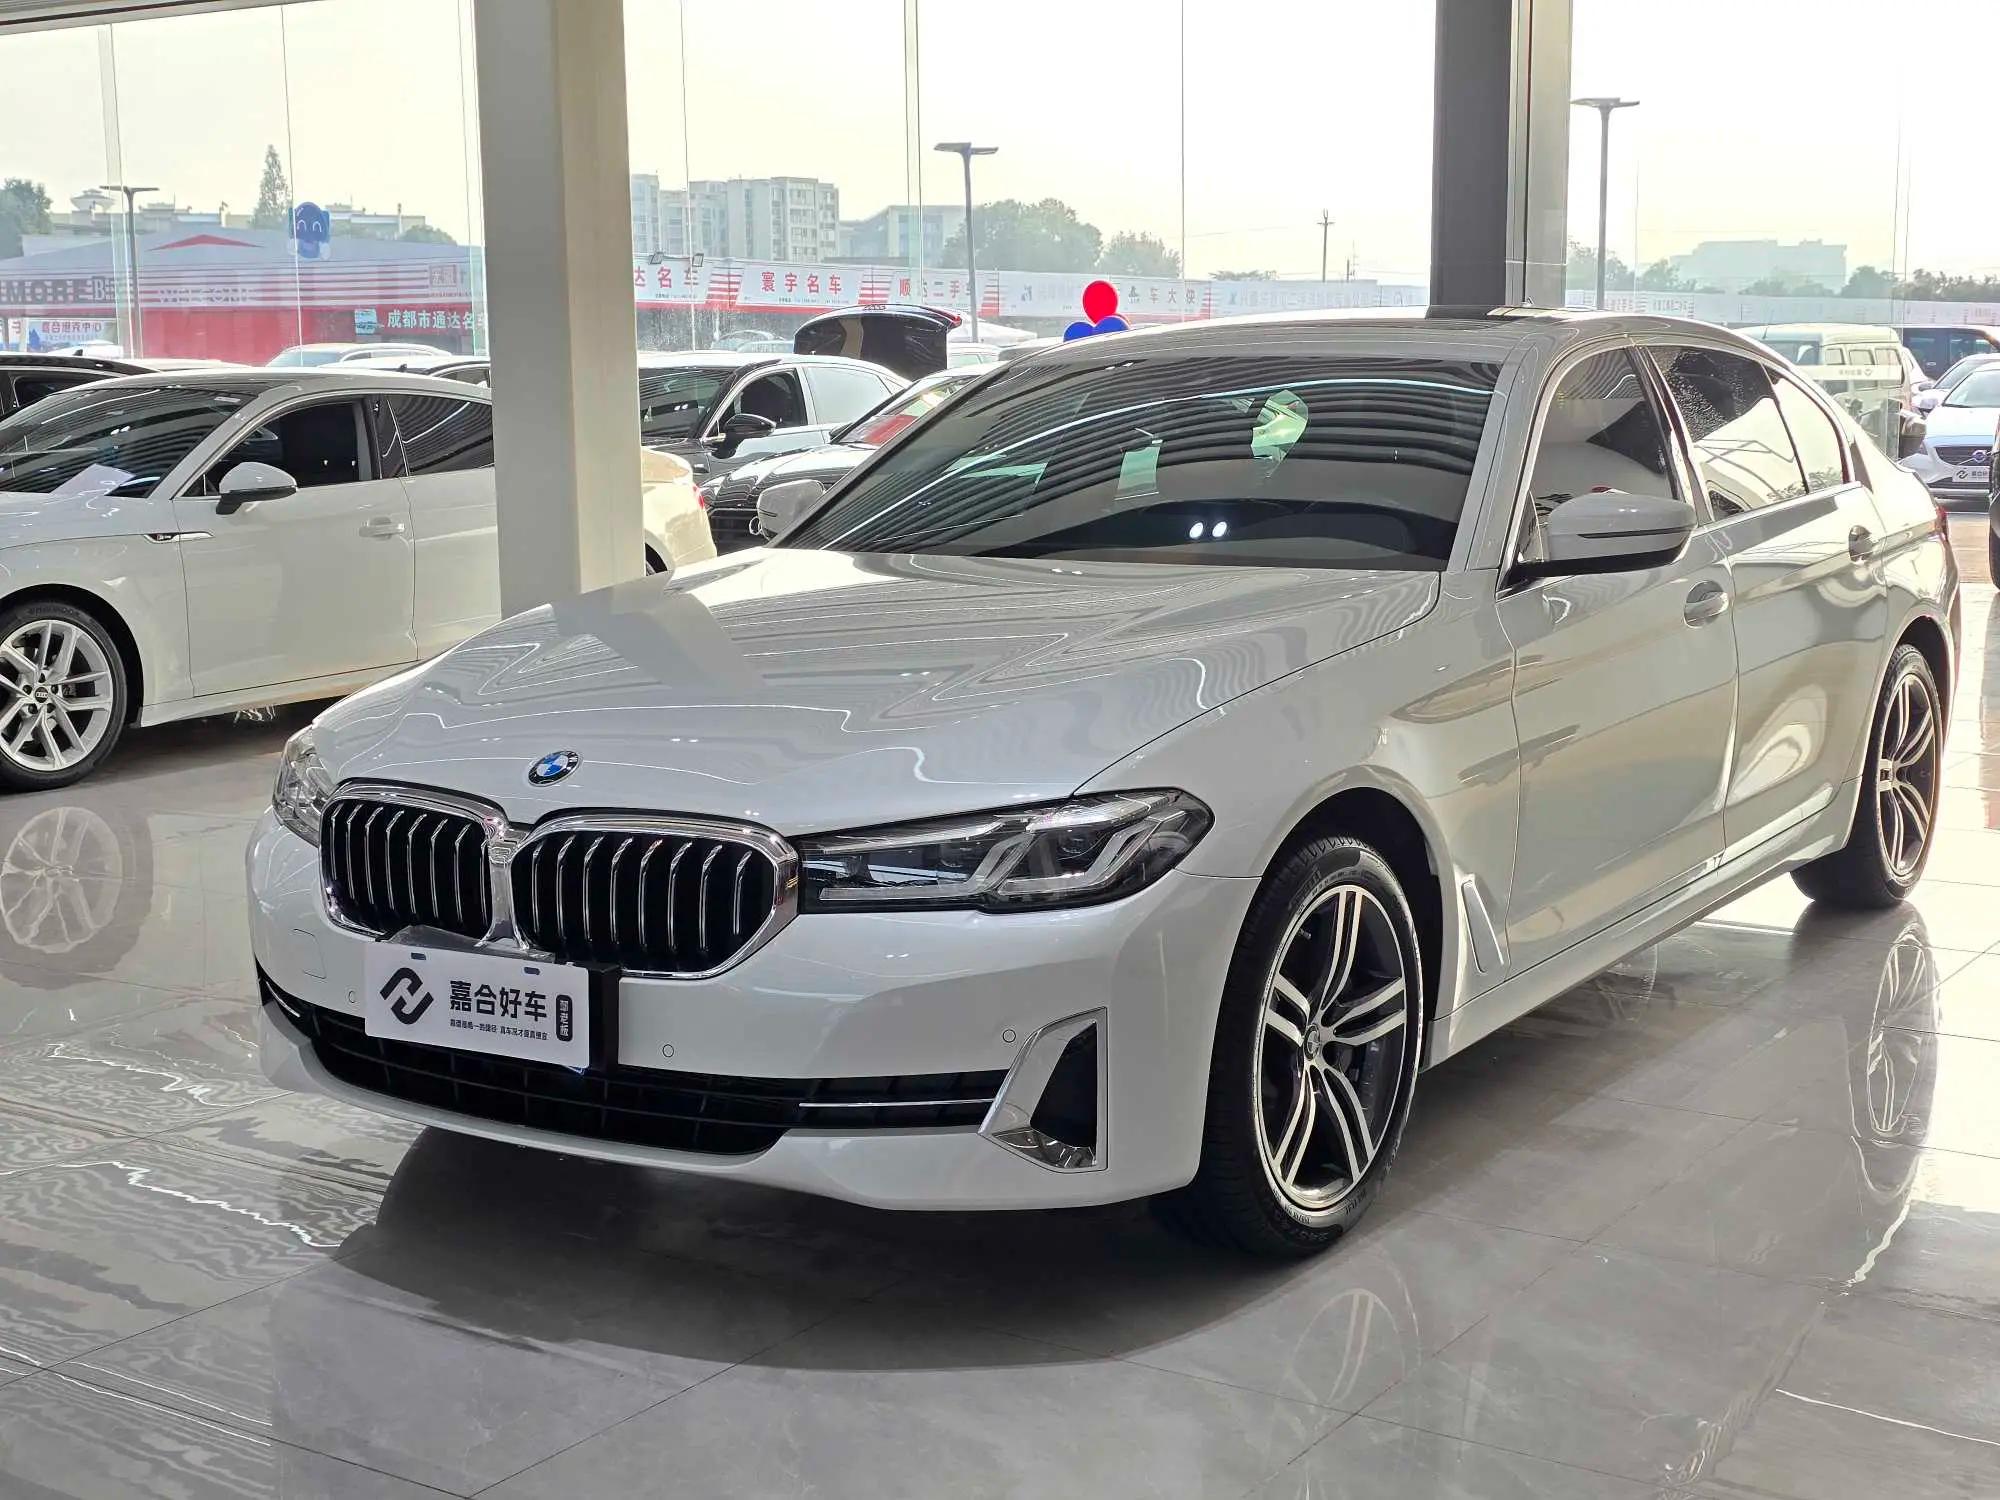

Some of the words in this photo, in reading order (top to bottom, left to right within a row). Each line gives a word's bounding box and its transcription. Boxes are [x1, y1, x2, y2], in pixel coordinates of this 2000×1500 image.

[762, 271, 842, 295] 寰宇名车
[899, 278, 970, 298] 顺二手
[450, 980, 547, 1021] 嘉合好车
